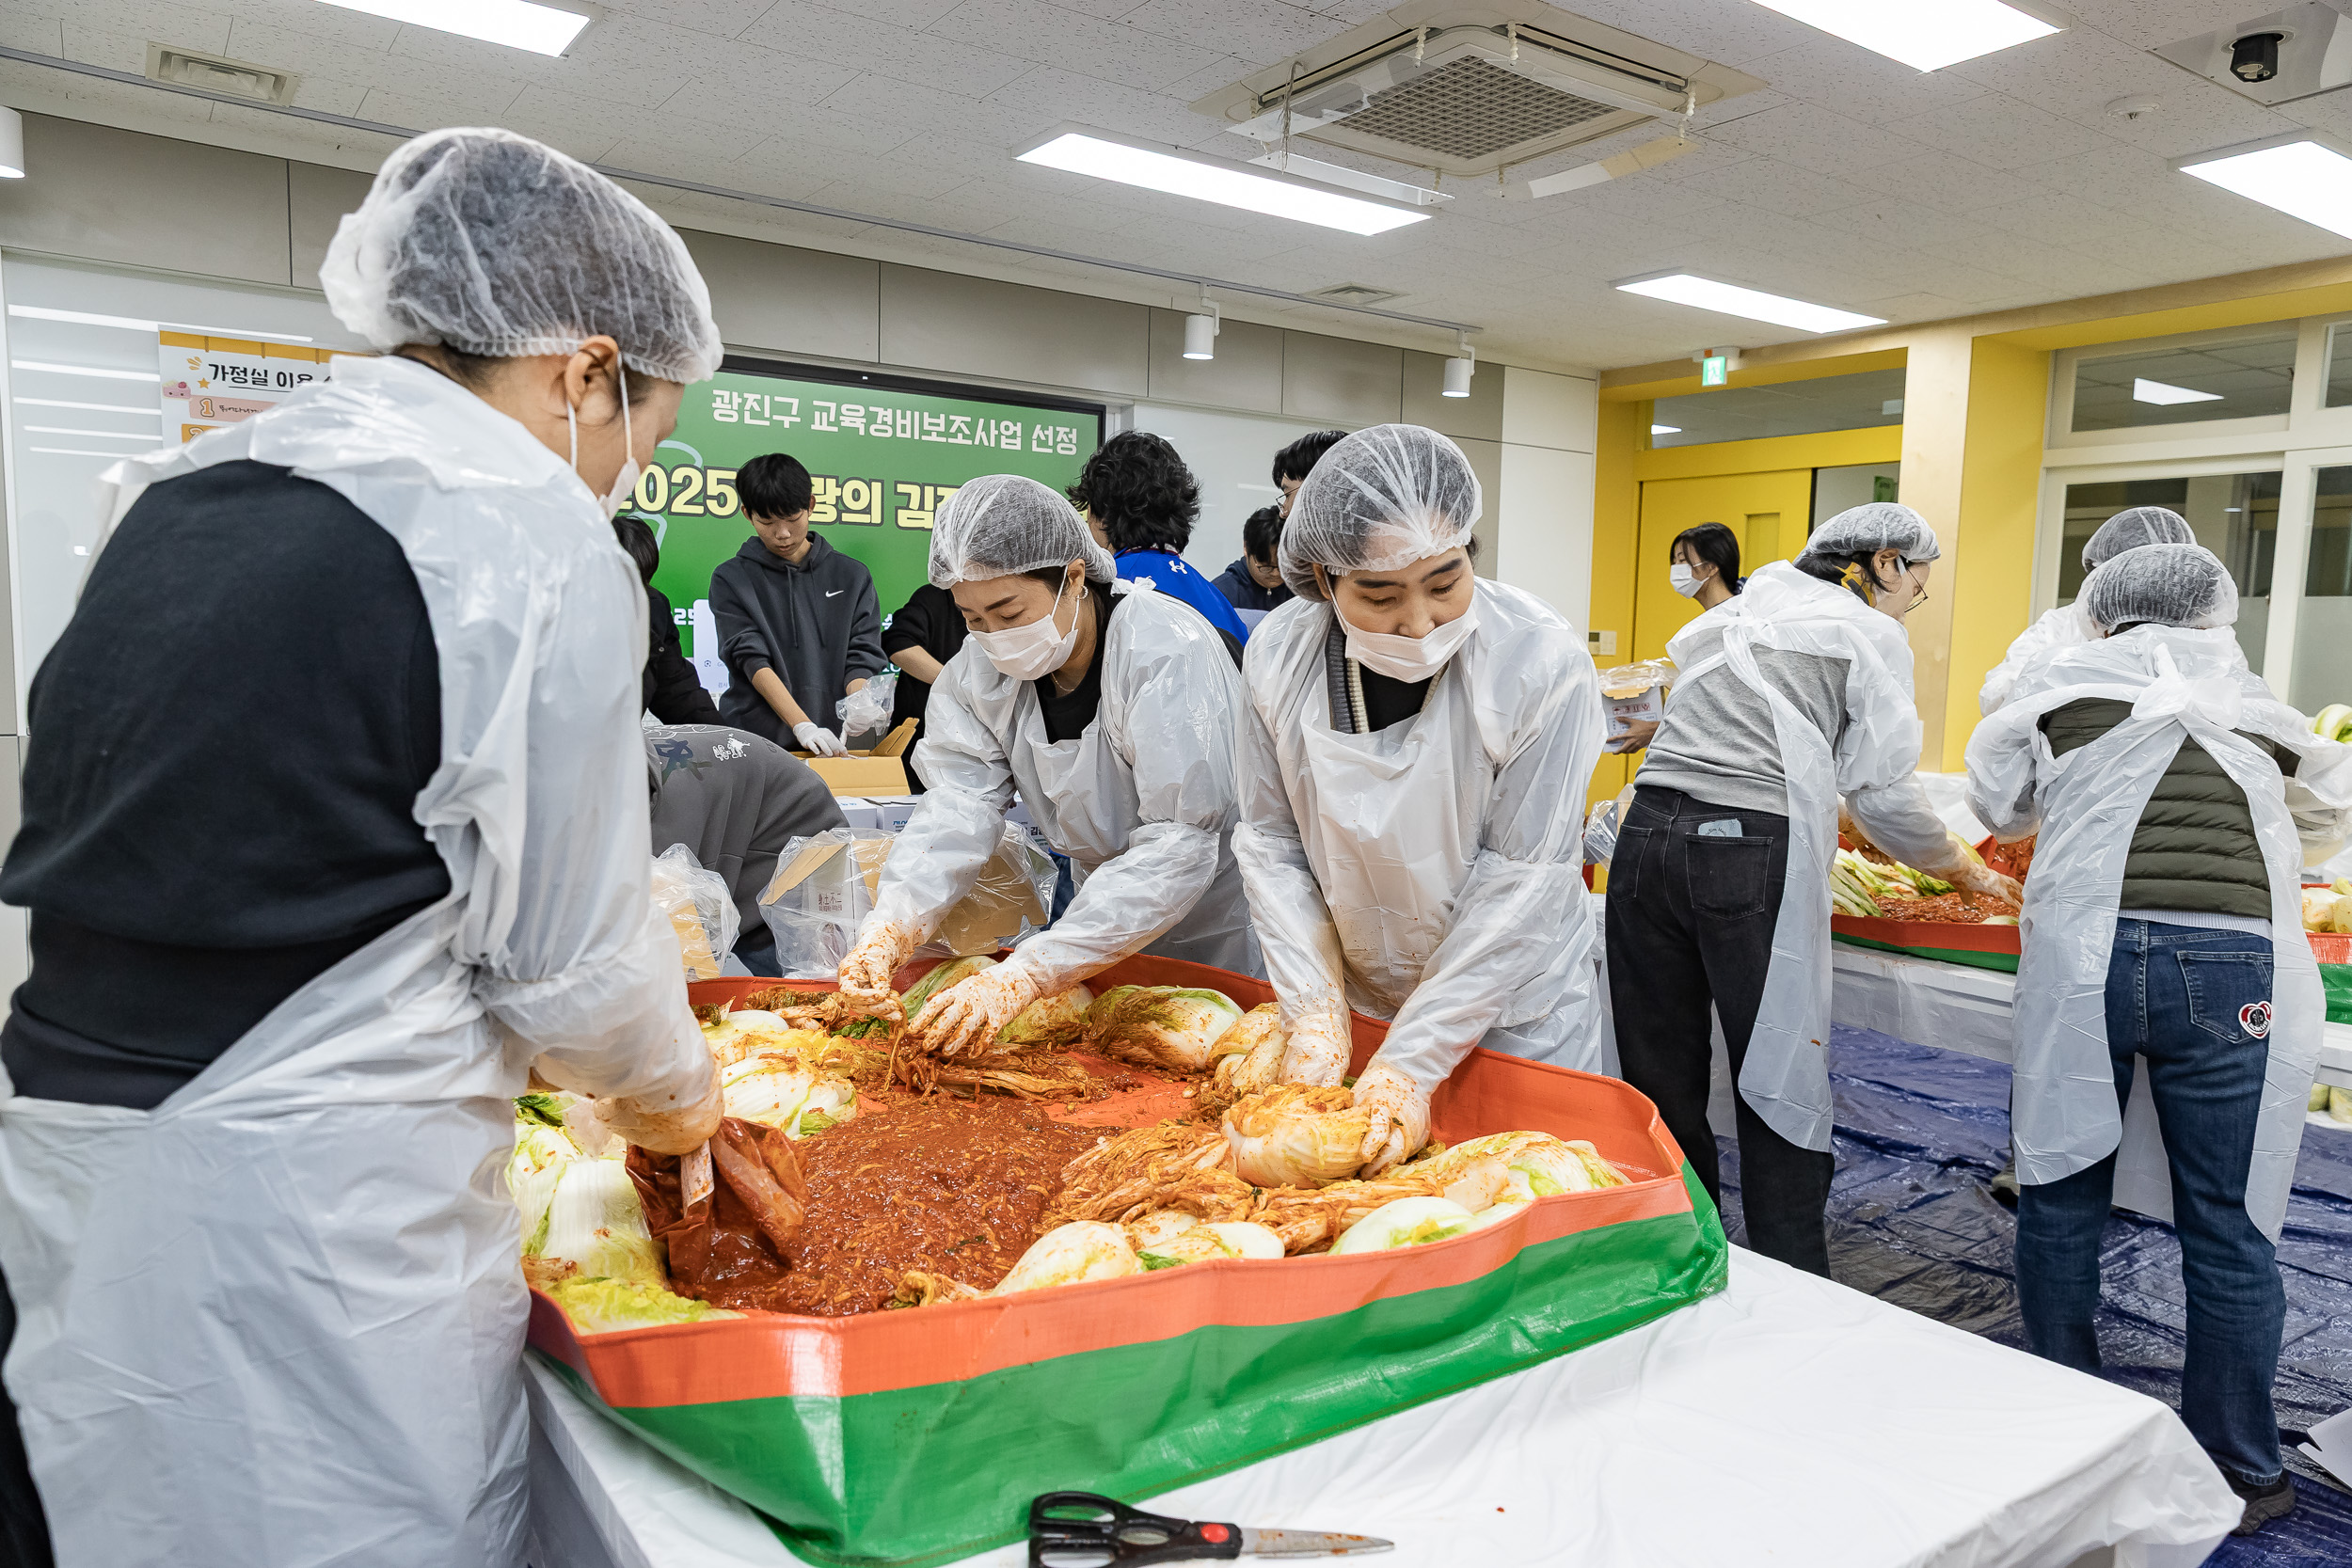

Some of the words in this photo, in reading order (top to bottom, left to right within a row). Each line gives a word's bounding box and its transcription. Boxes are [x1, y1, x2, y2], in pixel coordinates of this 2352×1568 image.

[208, 363, 269, 387] 가정실
[199, 398, 215, 418] 1
[711, 388, 802, 429] 광진구
[810, 399, 1022, 451] 교육경비보조사업
[1031, 422, 1078, 456] 선정
[808, 474, 882, 526] 랑의
